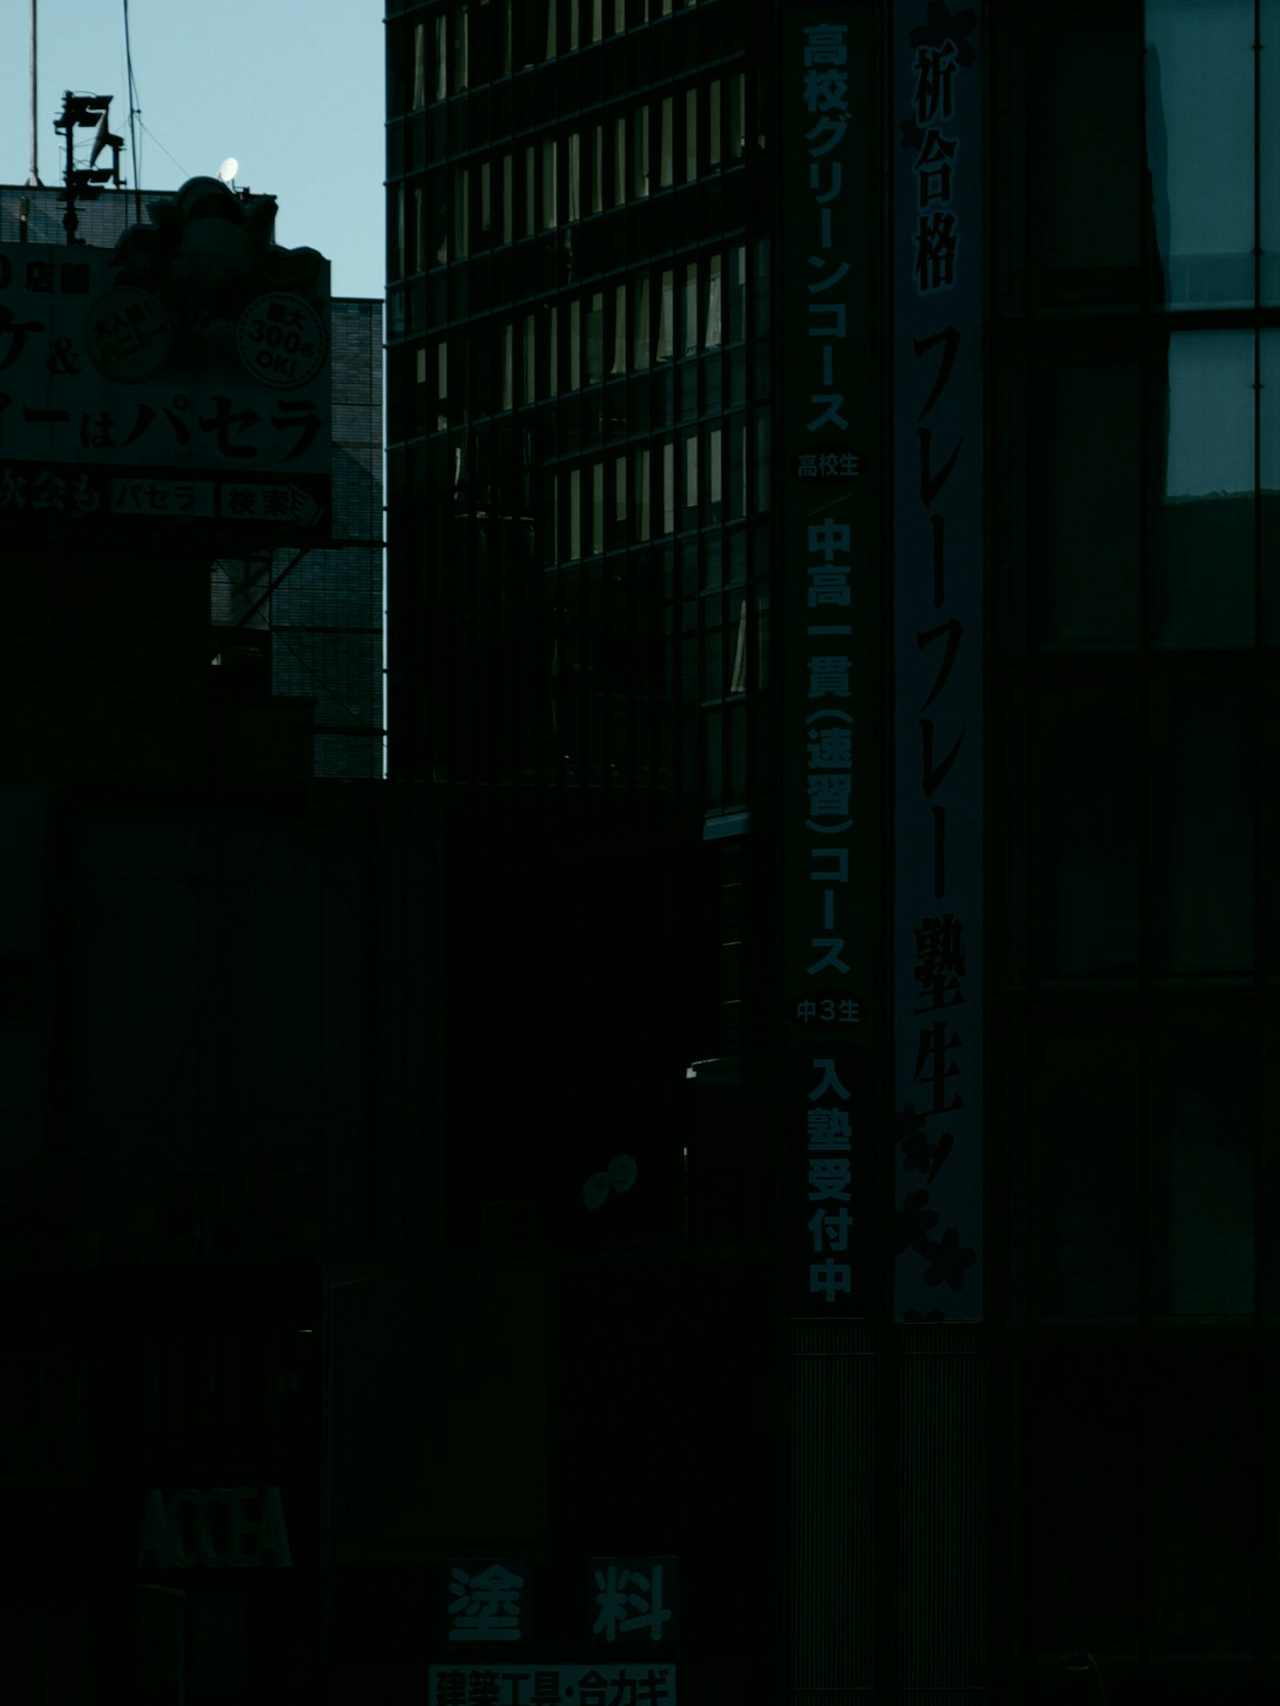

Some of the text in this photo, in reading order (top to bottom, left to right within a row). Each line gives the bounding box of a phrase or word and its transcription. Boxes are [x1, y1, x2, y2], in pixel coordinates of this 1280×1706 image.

[803, 22, 852, 433] 高校グリーンコース
[797, 453, 860, 478] 高校生
[805, 517, 854, 976] 中高一貫(速習)コース
[795, 998, 861, 1023] 中3生
[807, 1057, 853, 1303] 入塾受付中
[136, 1486, 294, 1568] ACCEA
[448, 1563, 671, 1642] 塗料
